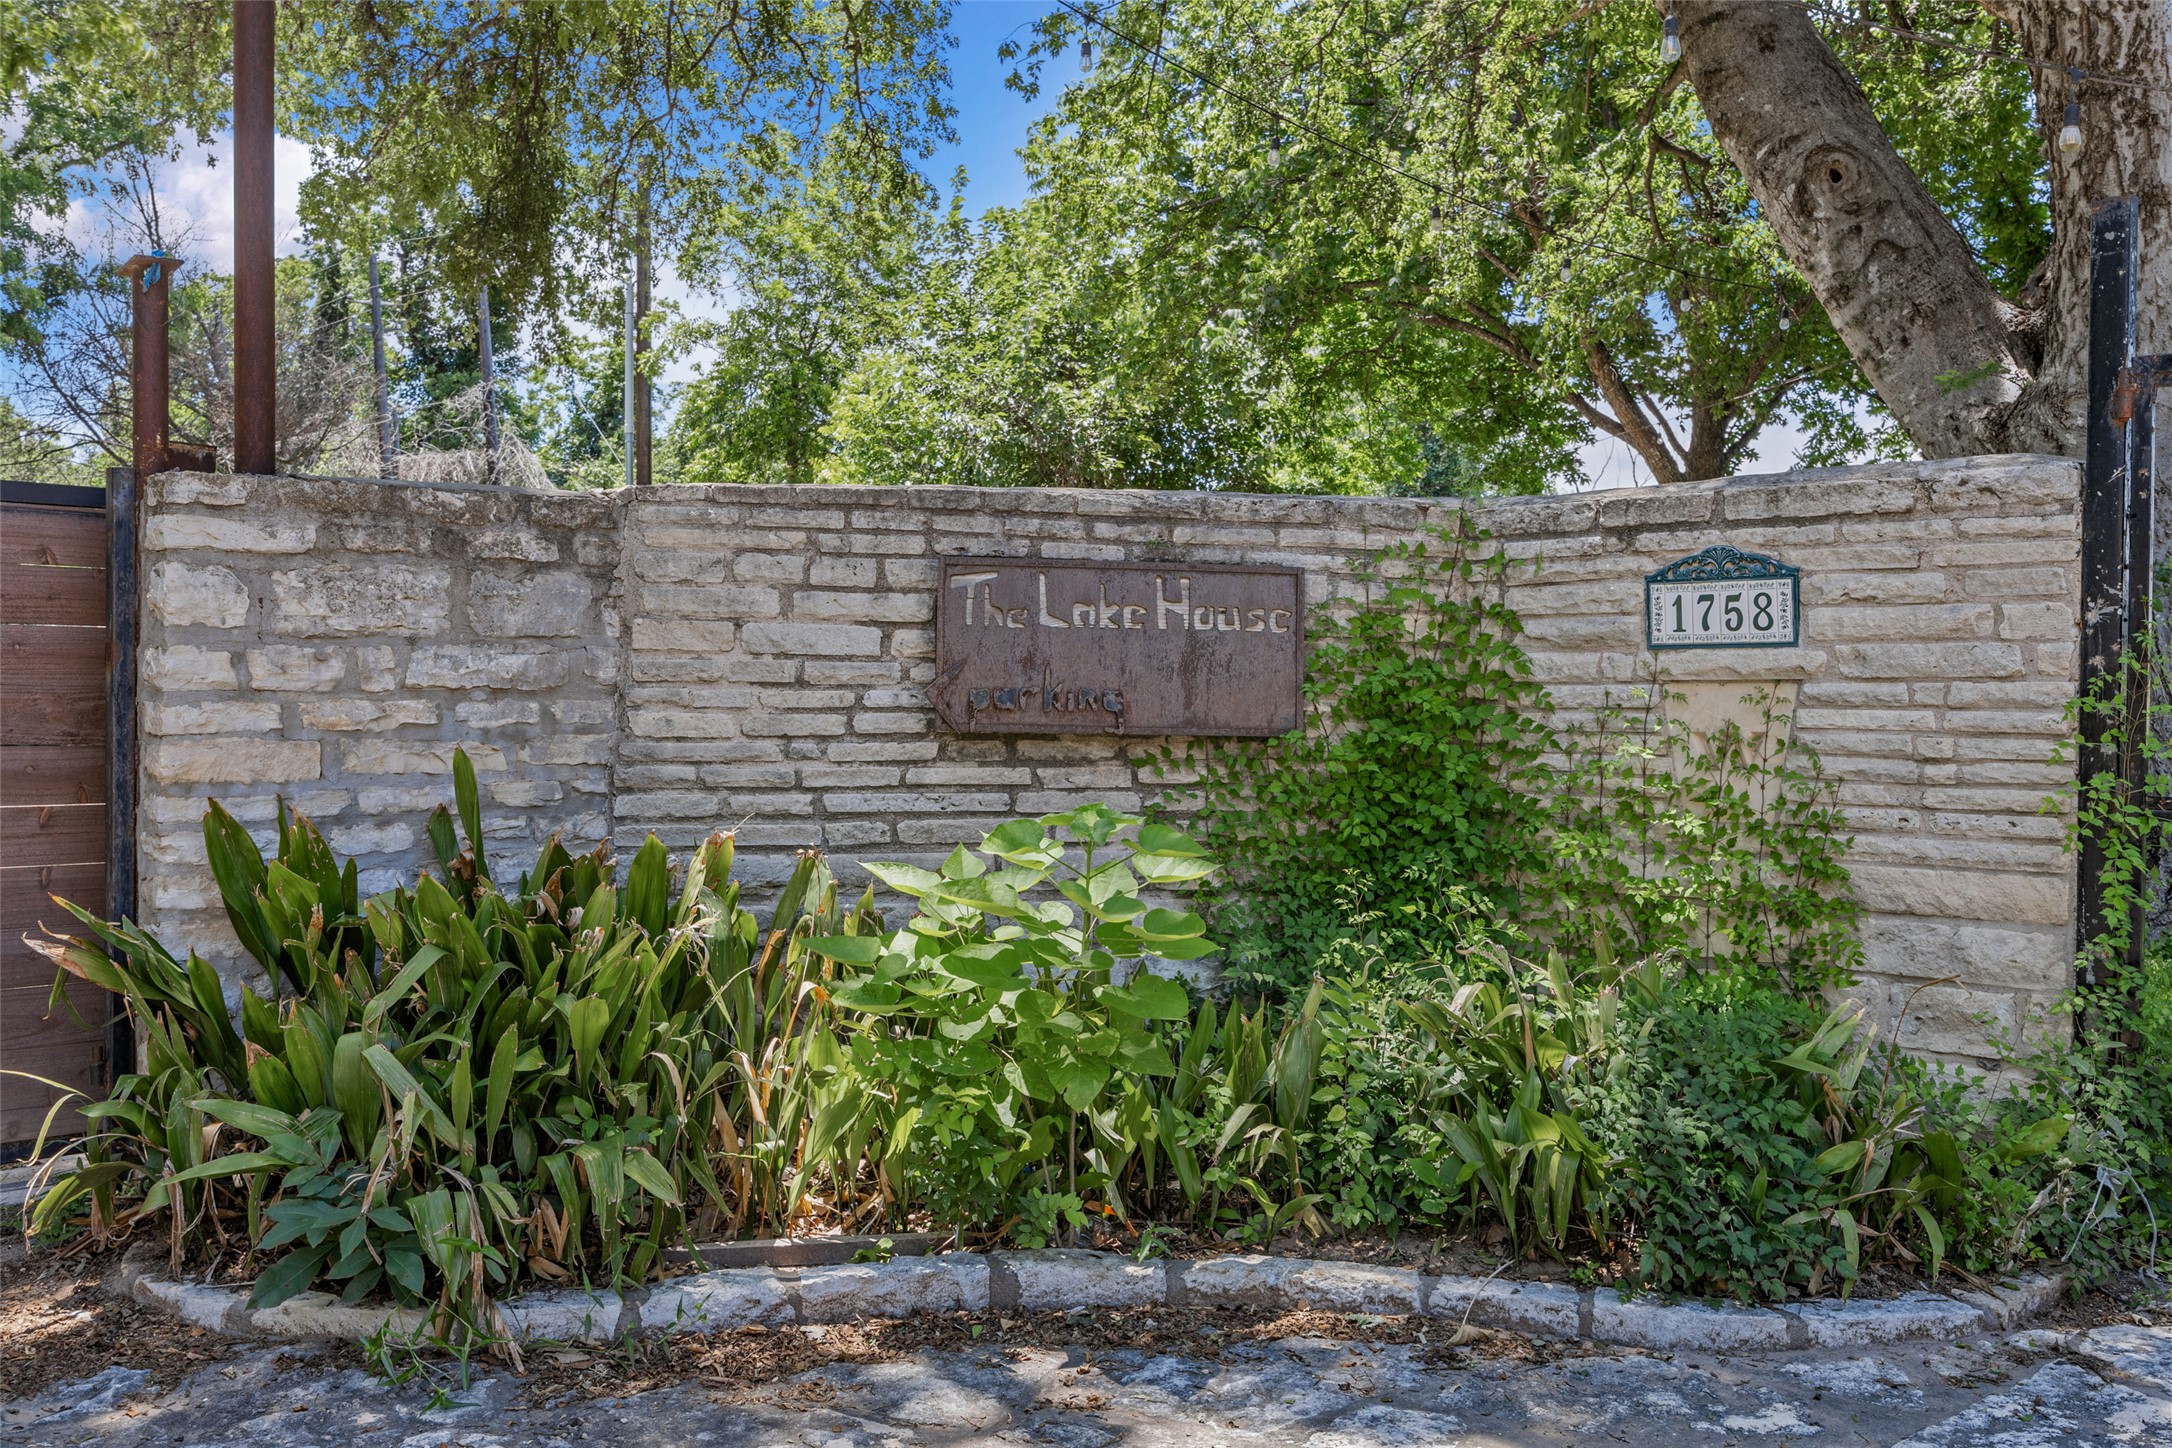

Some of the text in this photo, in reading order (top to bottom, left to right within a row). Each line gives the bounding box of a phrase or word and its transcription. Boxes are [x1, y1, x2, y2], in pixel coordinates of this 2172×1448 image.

[950, 571, 1292, 634] The Lake House
[1671, 591, 1774, 633] 1758
